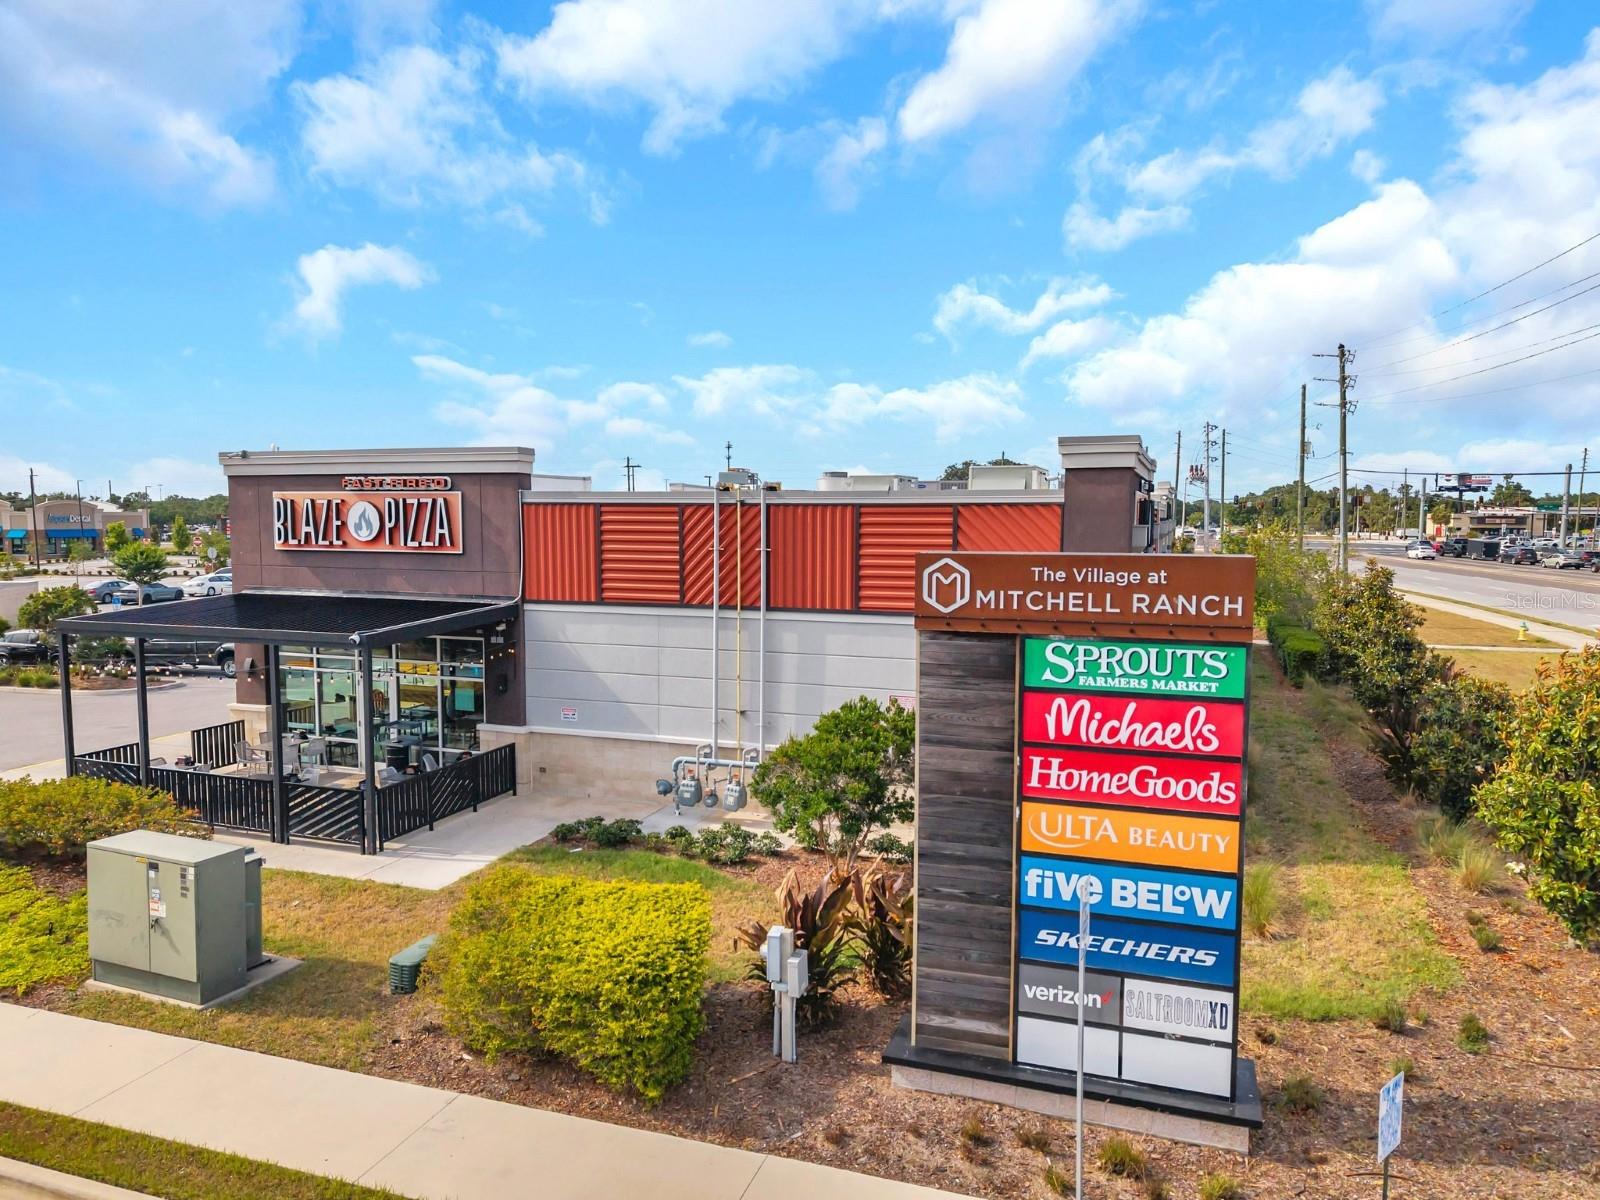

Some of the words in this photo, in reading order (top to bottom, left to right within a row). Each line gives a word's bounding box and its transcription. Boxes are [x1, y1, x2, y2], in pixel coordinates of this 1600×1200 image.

[273, 498, 343, 546] BLAZE
[385, 497, 451, 547] PIZZA
[1031, 567, 1066, 582] The
[1073, 567, 1141, 586] Village
[1147, 569, 1168, 584] at
[975, 590, 1121, 614] MITCHELL
[1132, 594, 1244, 617] RANCH
[1041, 641, 1229, 684] SPROUTS
[1078, 675, 1148, 689] FARMERS
[1152, 679, 1219, 693] MARKET
[1045, 696, 1220, 752] Michaels
[1027, 755, 1237, 804] HomeGoods
[1039, 811, 1118, 844] ULTA
[1128, 827, 1231, 855] BEAUTY
[1024, 868, 1105, 905] five
[1111, 878, 1232, 920] BELOW
[1034, 929, 1220, 967] SKECHERS
[1023, 983, 1102, 1009] verizon
